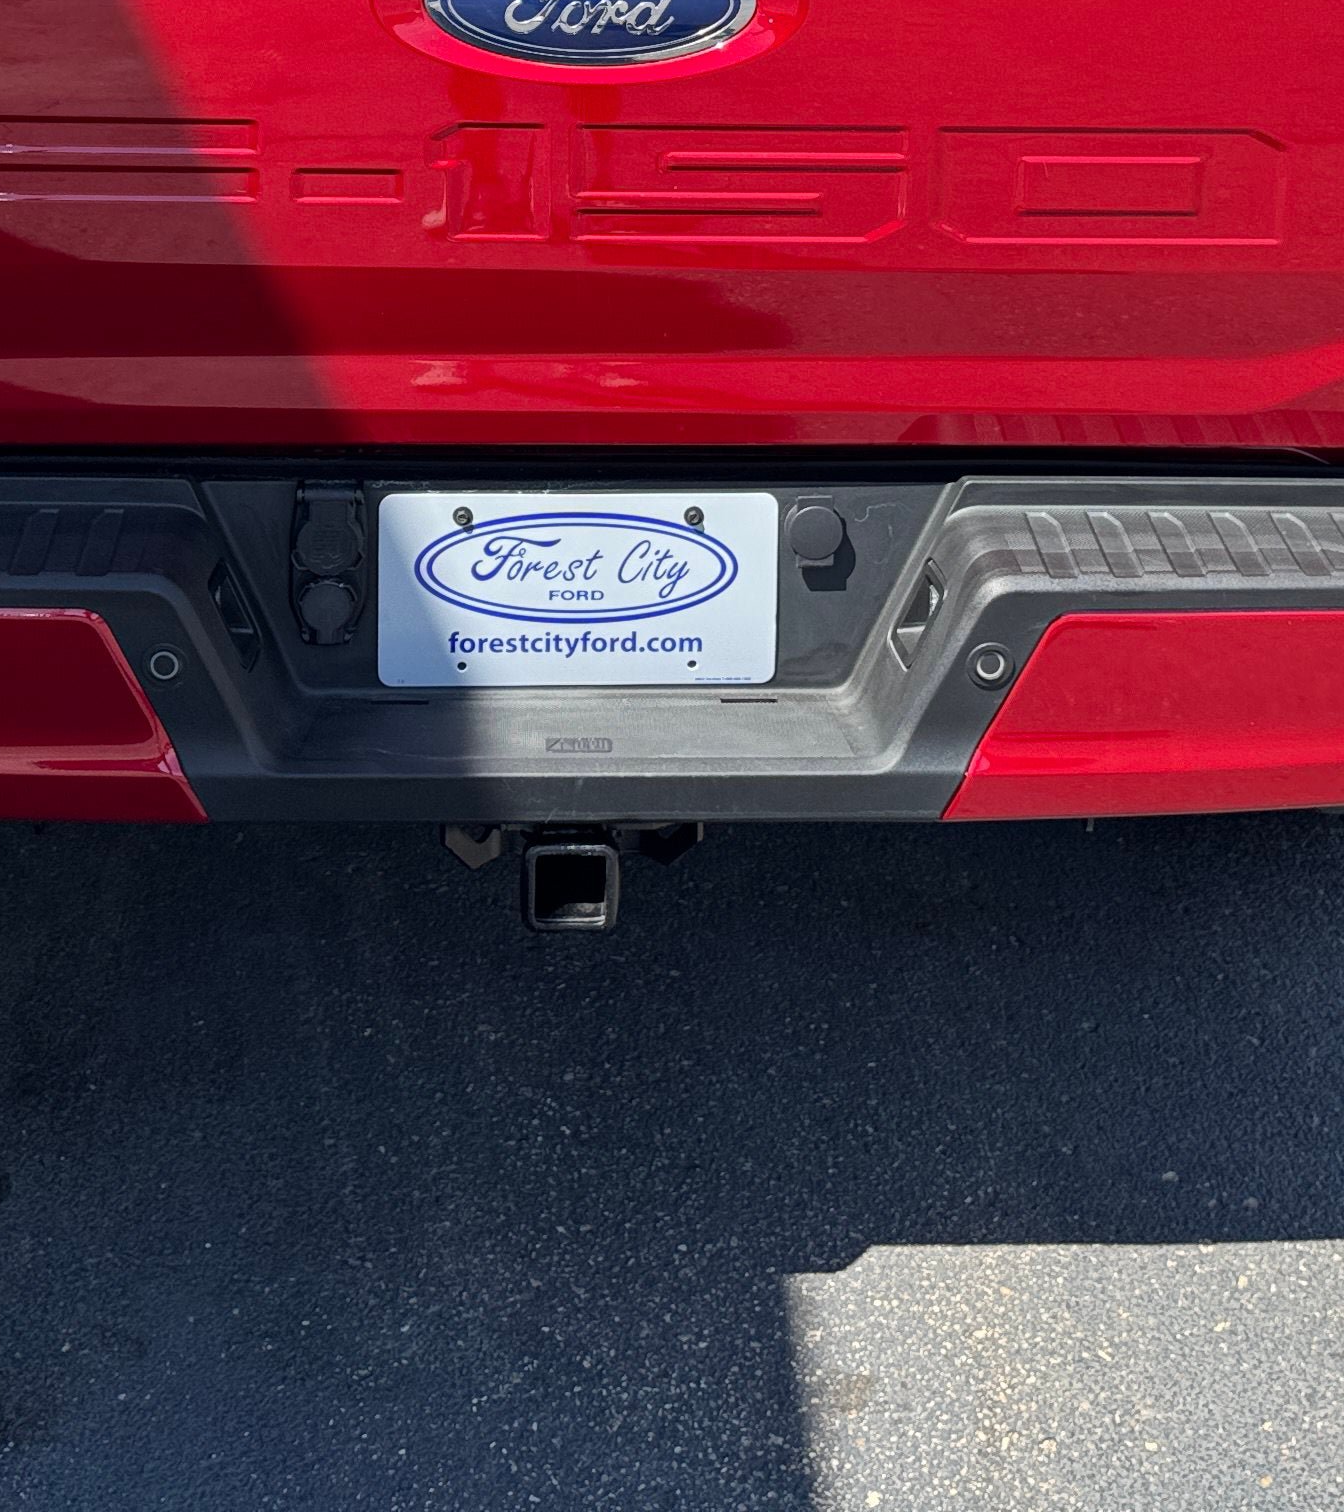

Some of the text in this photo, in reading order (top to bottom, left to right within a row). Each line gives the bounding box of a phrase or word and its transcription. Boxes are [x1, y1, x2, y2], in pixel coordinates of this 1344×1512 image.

[471, 536, 690, 599] Forest City
[548, 590, 605, 601] FORD
[449, 631, 703, 658] forestcityford.com
